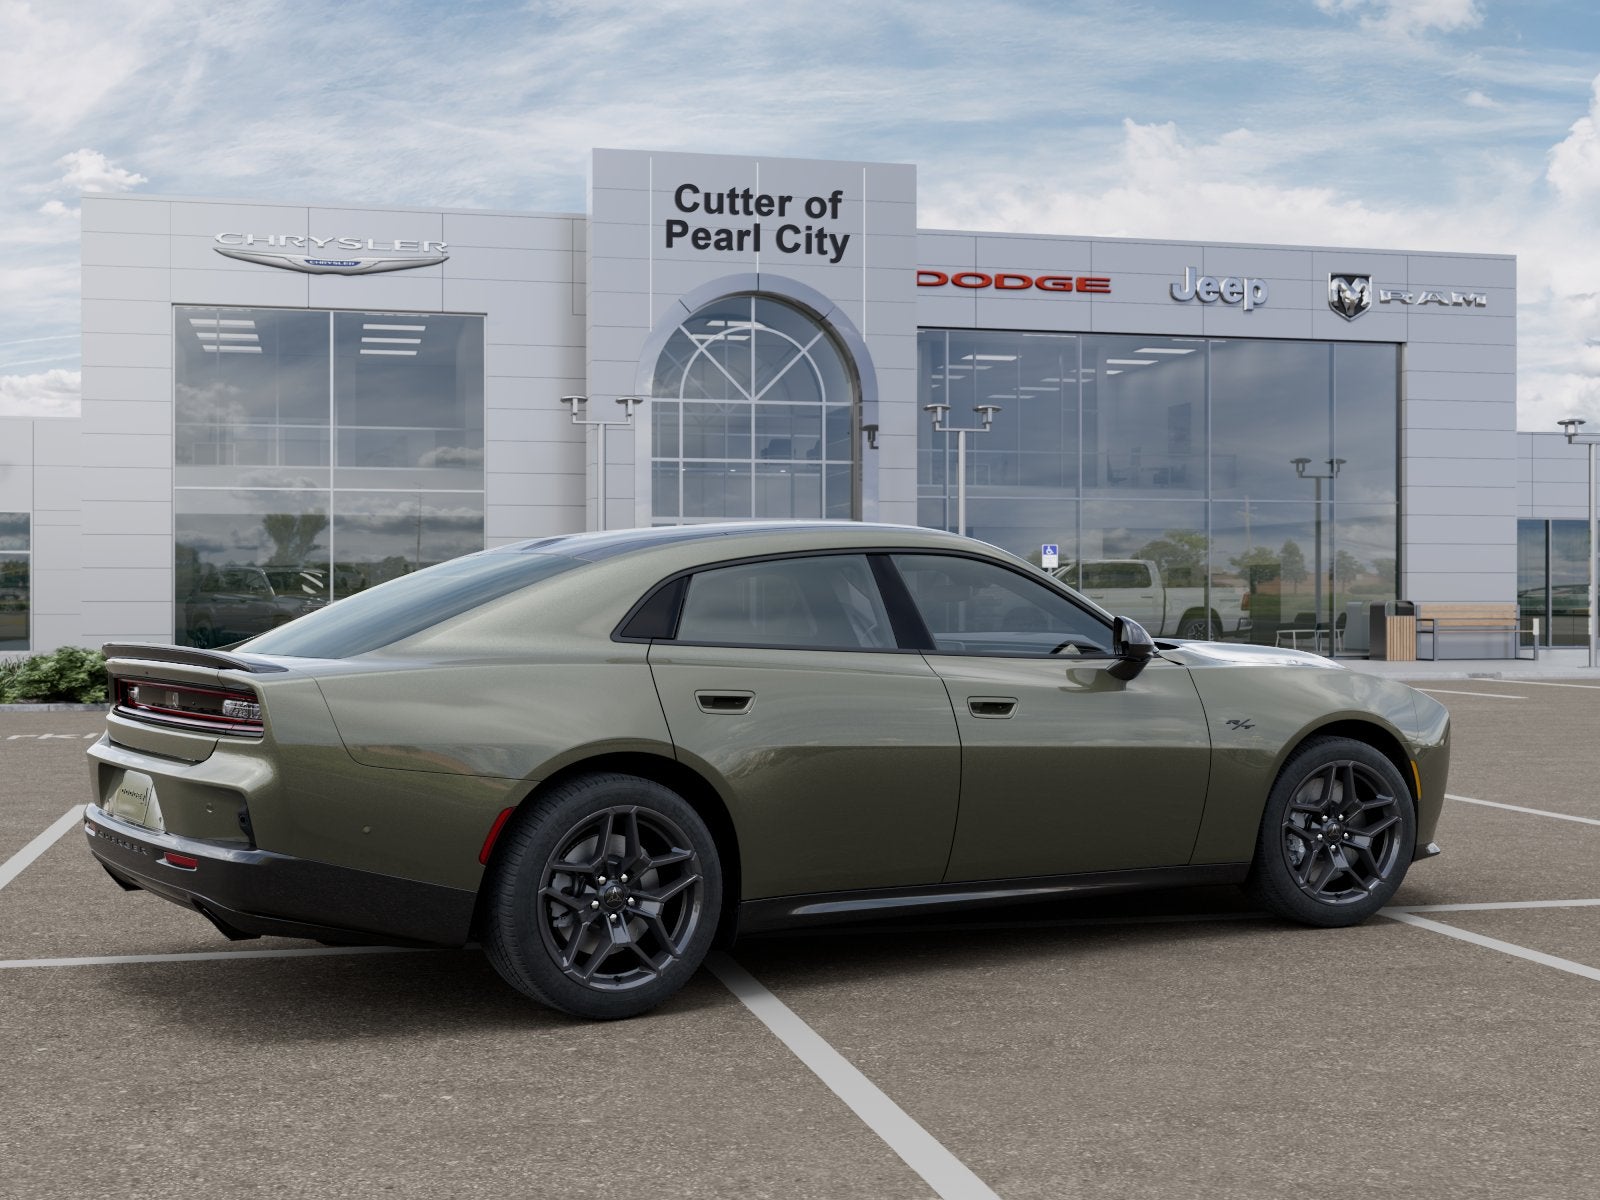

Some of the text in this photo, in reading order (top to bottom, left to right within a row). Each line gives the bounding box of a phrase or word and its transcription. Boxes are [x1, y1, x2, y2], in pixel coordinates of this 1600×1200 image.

[674, 183, 844, 219] Cutter of
[214, 232, 448, 253] CHRYSLER
[665, 219, 850, 263] Pearl City
[917, 270, 1112, 294] DODGE
[1169, 266, 1269, 311] Jeep
[1379, 289, 1488, 307] RAM
